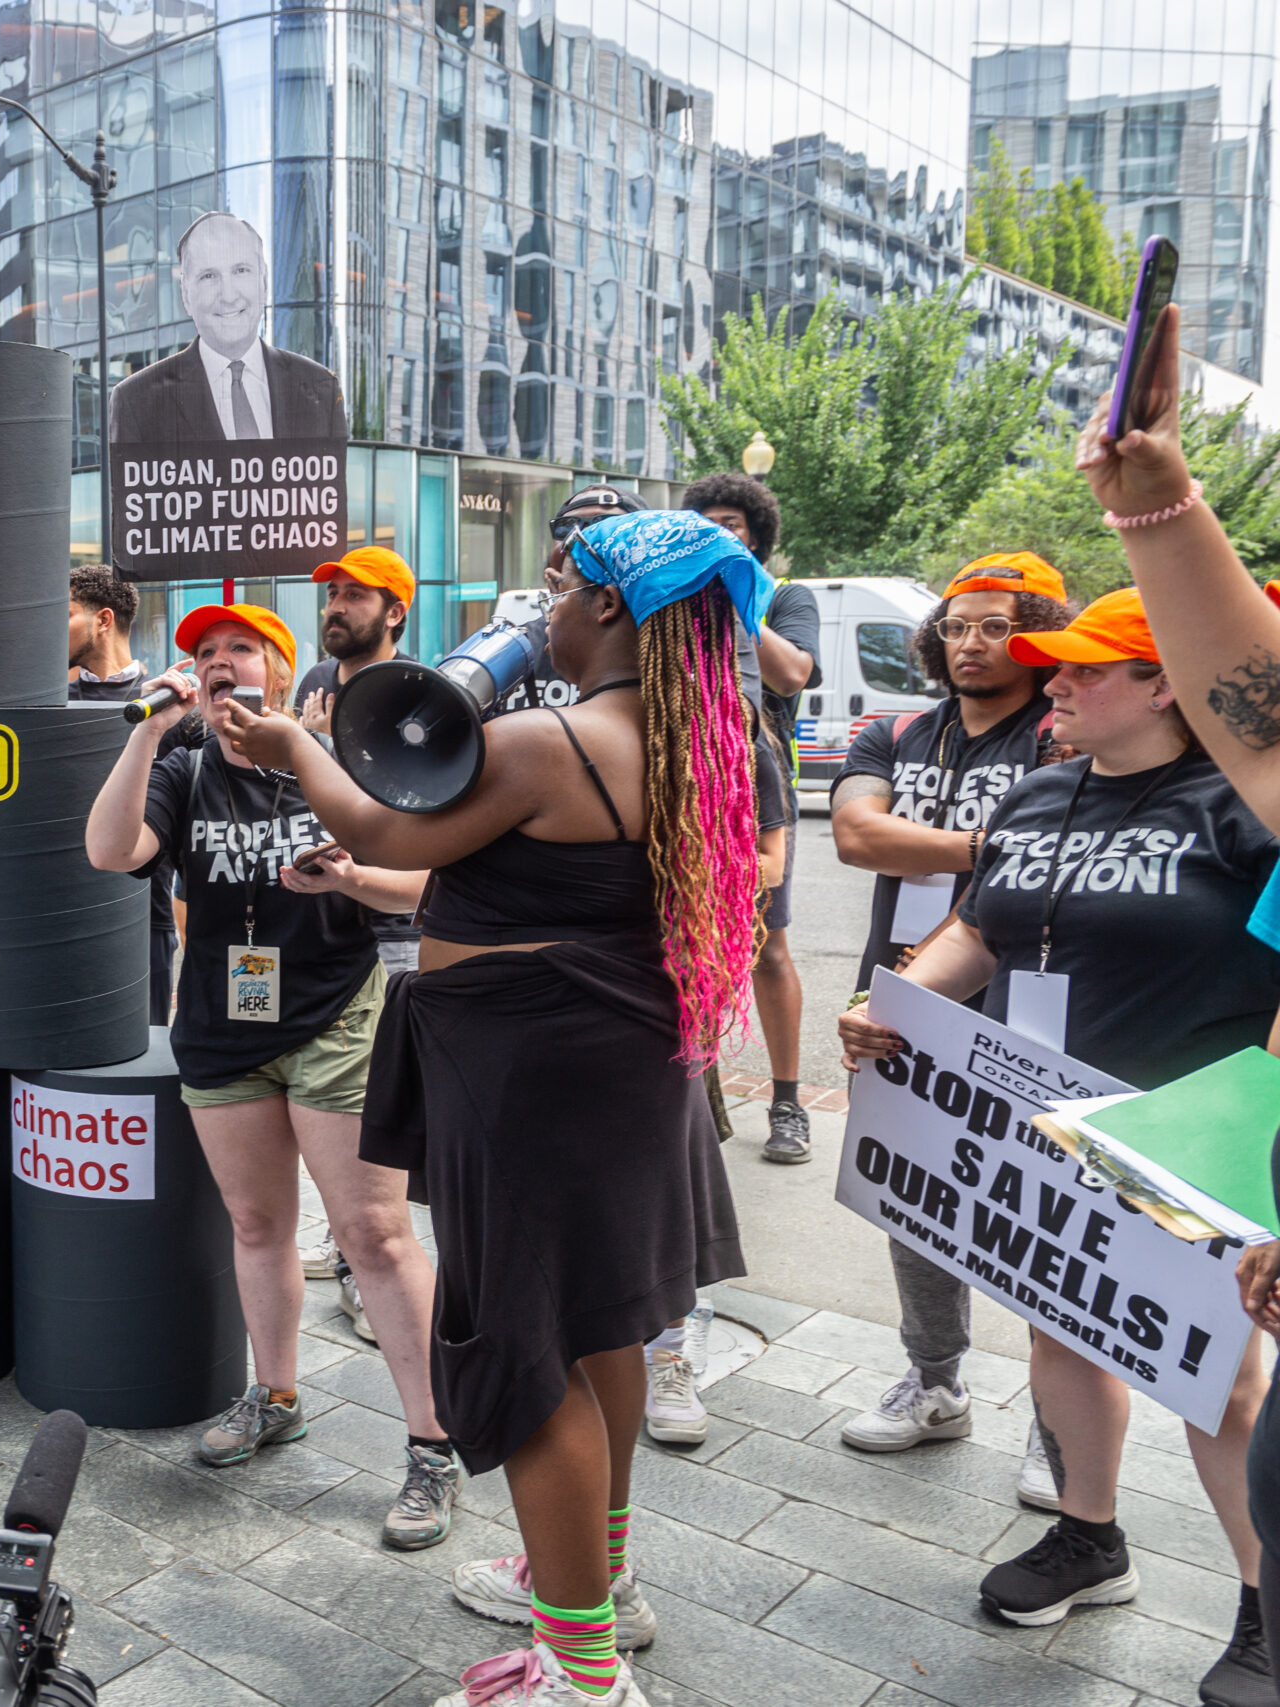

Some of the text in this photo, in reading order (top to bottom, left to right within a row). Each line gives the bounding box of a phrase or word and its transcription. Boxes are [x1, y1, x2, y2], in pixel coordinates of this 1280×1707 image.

[124, 455, 338, 487] DUGAN, DO GOOD
[125, 486, 338, 522] STOP FUNDING
[126, 520, 338, 556] CLIMATE CHAOS
[237, 996, 272, 1012] HERE
[973, 1031, 1049, 1077] River
[13, 1089, 149, 1147] climate
[875, 1033, 1067, 1165] Stop the
[20, 1139, 130, 1193] chaos
[855, 1136, 961, 1231] OUR
[971, 1201, 1169, 1352] WELLS
